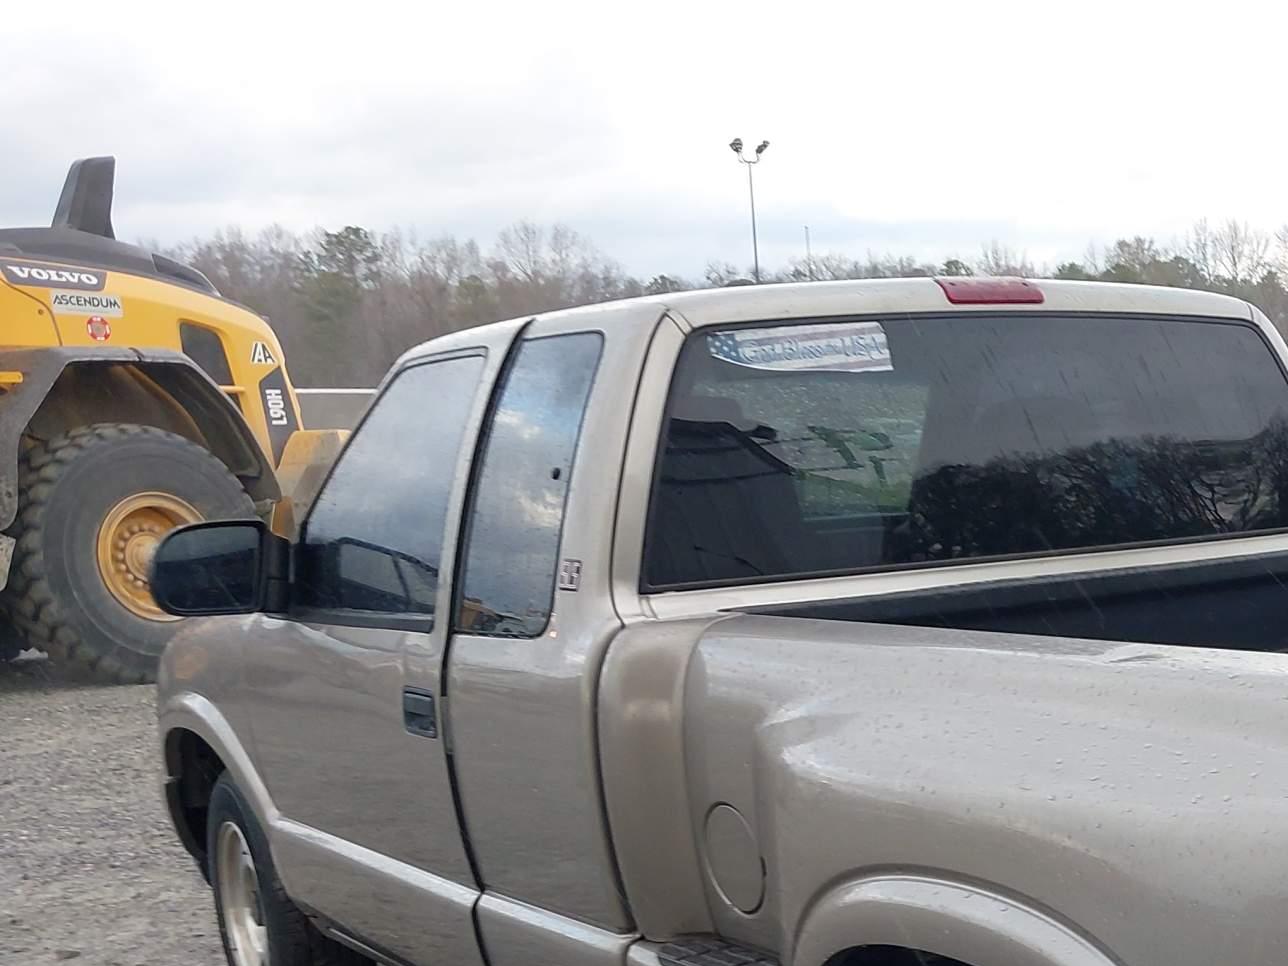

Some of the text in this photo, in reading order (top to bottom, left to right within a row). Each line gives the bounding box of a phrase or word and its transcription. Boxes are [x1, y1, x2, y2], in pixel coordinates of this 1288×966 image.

[7, 265, 99, 285] VOLVO
[53, 294, 121, 309] ASCENDUM
[265, 389, 288, 426] L90H
